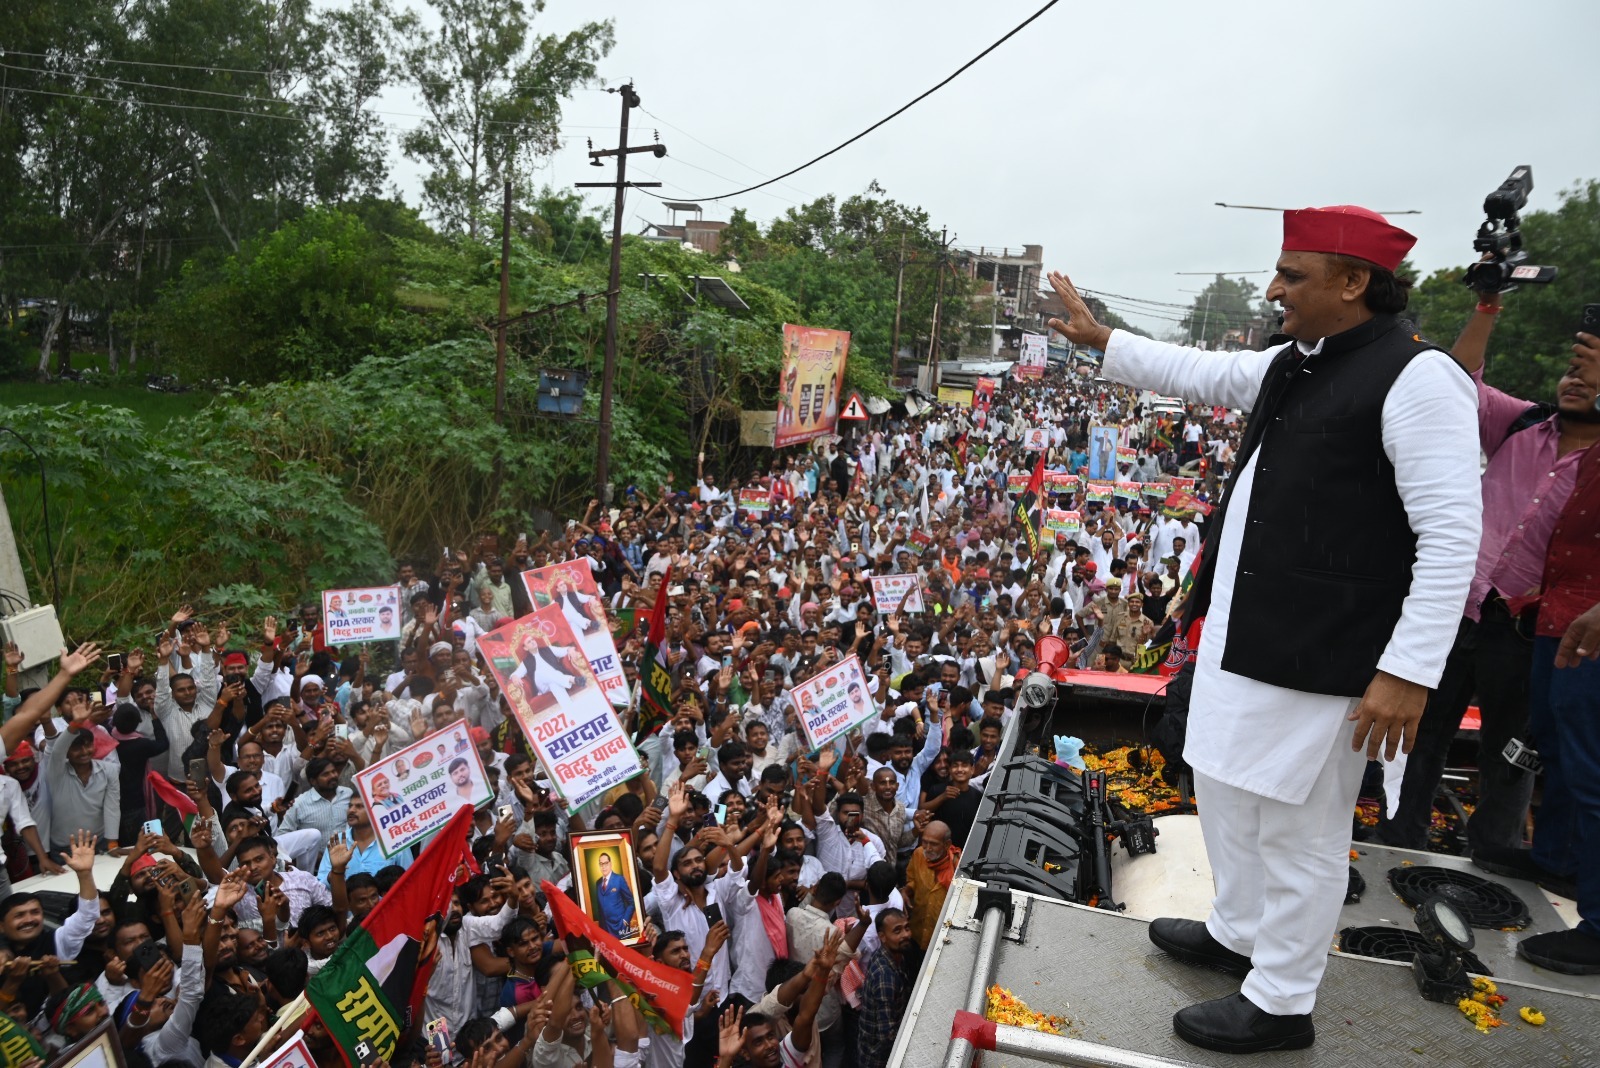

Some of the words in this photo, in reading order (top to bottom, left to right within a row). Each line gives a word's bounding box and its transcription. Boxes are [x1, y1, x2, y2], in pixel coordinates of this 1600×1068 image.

[329, 619, 350, 628] PDA
[351, 616, 375, 626] सरकार
[808, 713, 828, 731] PDA
[826, 699, 848, 718] सरकार
[545, 712, 612, 760] सरदार
[554, 754, 597, 785] बिट्टू
[590, 735, 627, 762] यादव
[1517, 752, 1541, 769] ANI
[401, 774, 429, 797] अबकी
[429, 766, 446, 781] बार
[379, 804, 412, 830] PDA
[411, 782, 448, 809] सरकार
[388, 818, 419, 840] बिट्टू
[418, 800, 447, 820] यादव
[623, 960, 644, 978] यादव
